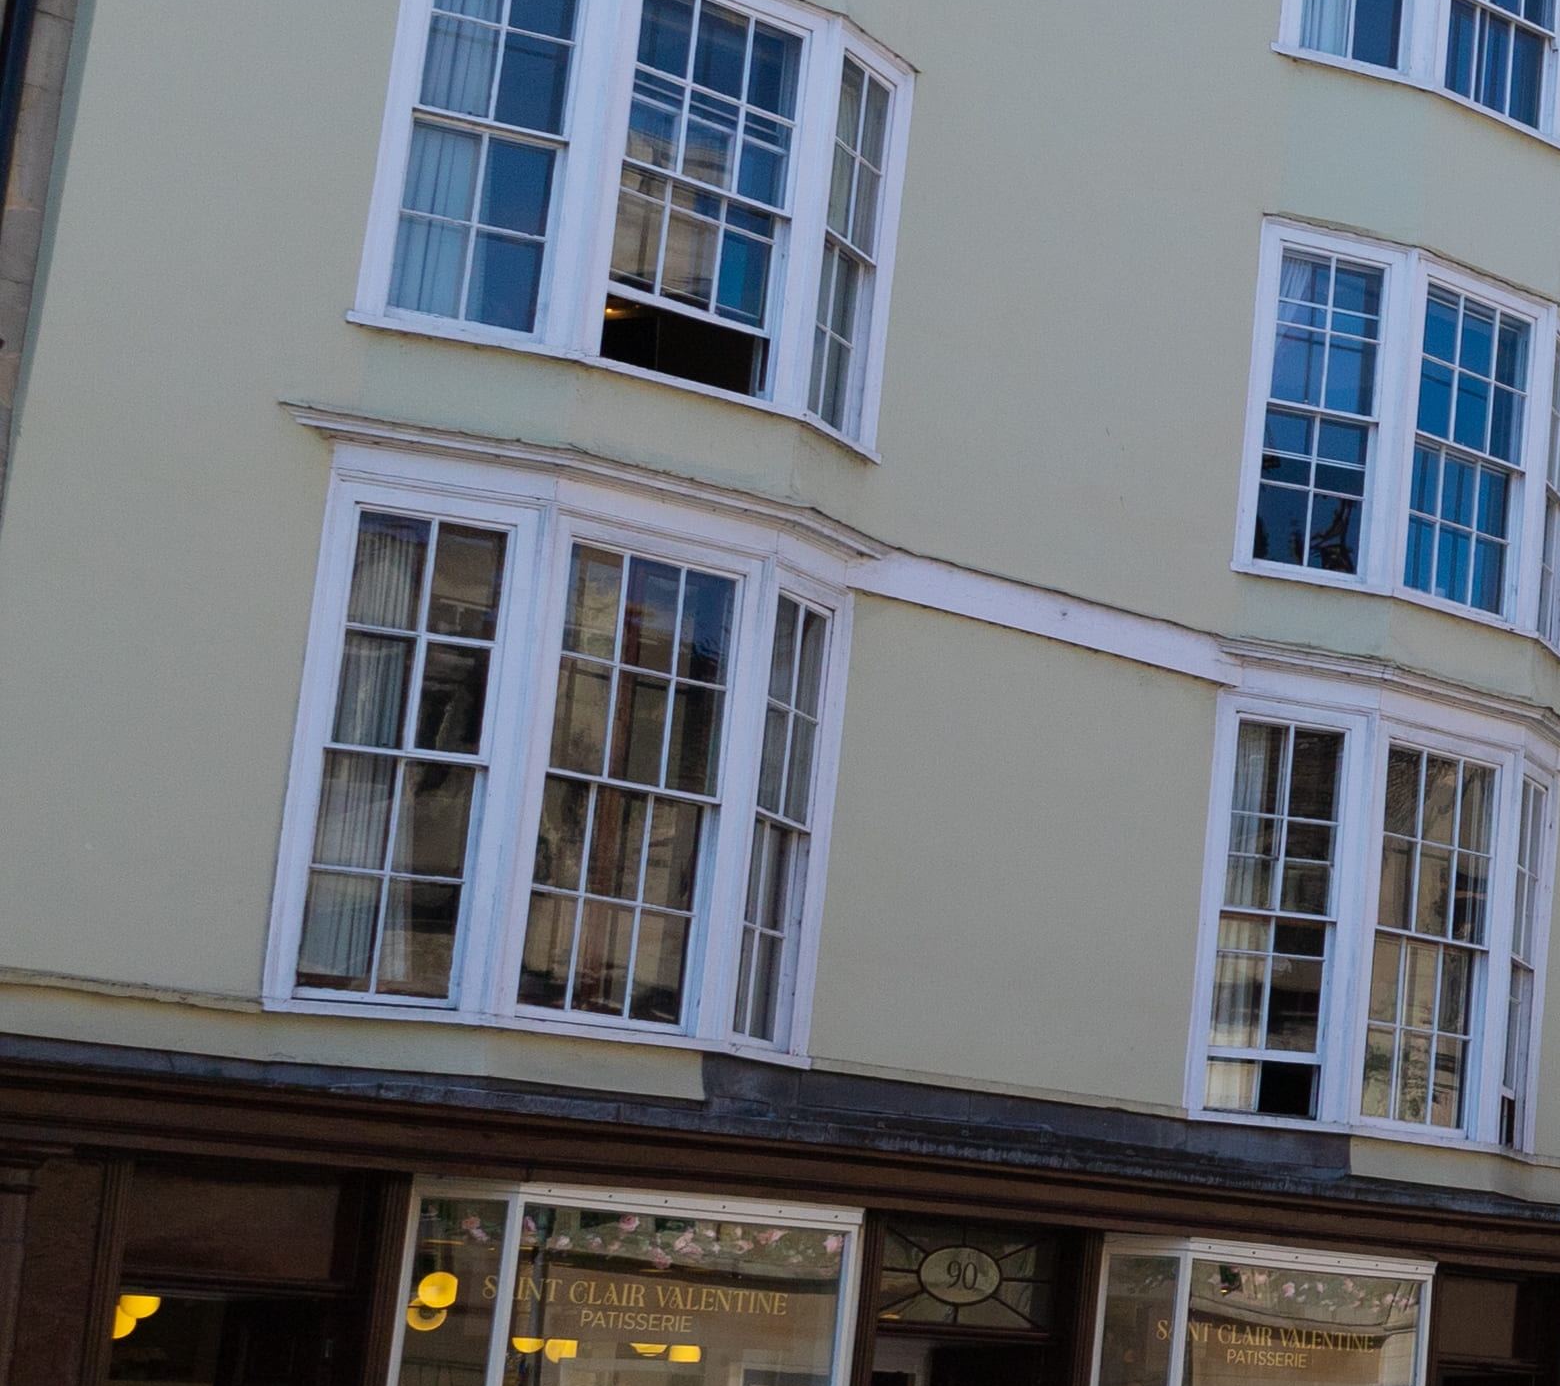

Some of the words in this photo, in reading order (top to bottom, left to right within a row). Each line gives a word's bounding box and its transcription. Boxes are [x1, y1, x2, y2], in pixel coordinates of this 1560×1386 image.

[947, 1260, 977, 1290] 90
[482, 1274, 562, 1302] SINT
[569, 1280, 645, 1308] CLAIR
[656, 1285, 788, 1316] VALENTINE
[580, 1310, 693, 1333] PATISSERIE
[1156, 1320, 1212, 1342] SNT
[1217, 1324, 1273, 1348] CLAIR
[1280, 1328, 1376, 1353] VALENTINE
[1227, 1349, 1307, 1369] PATISSERIE
